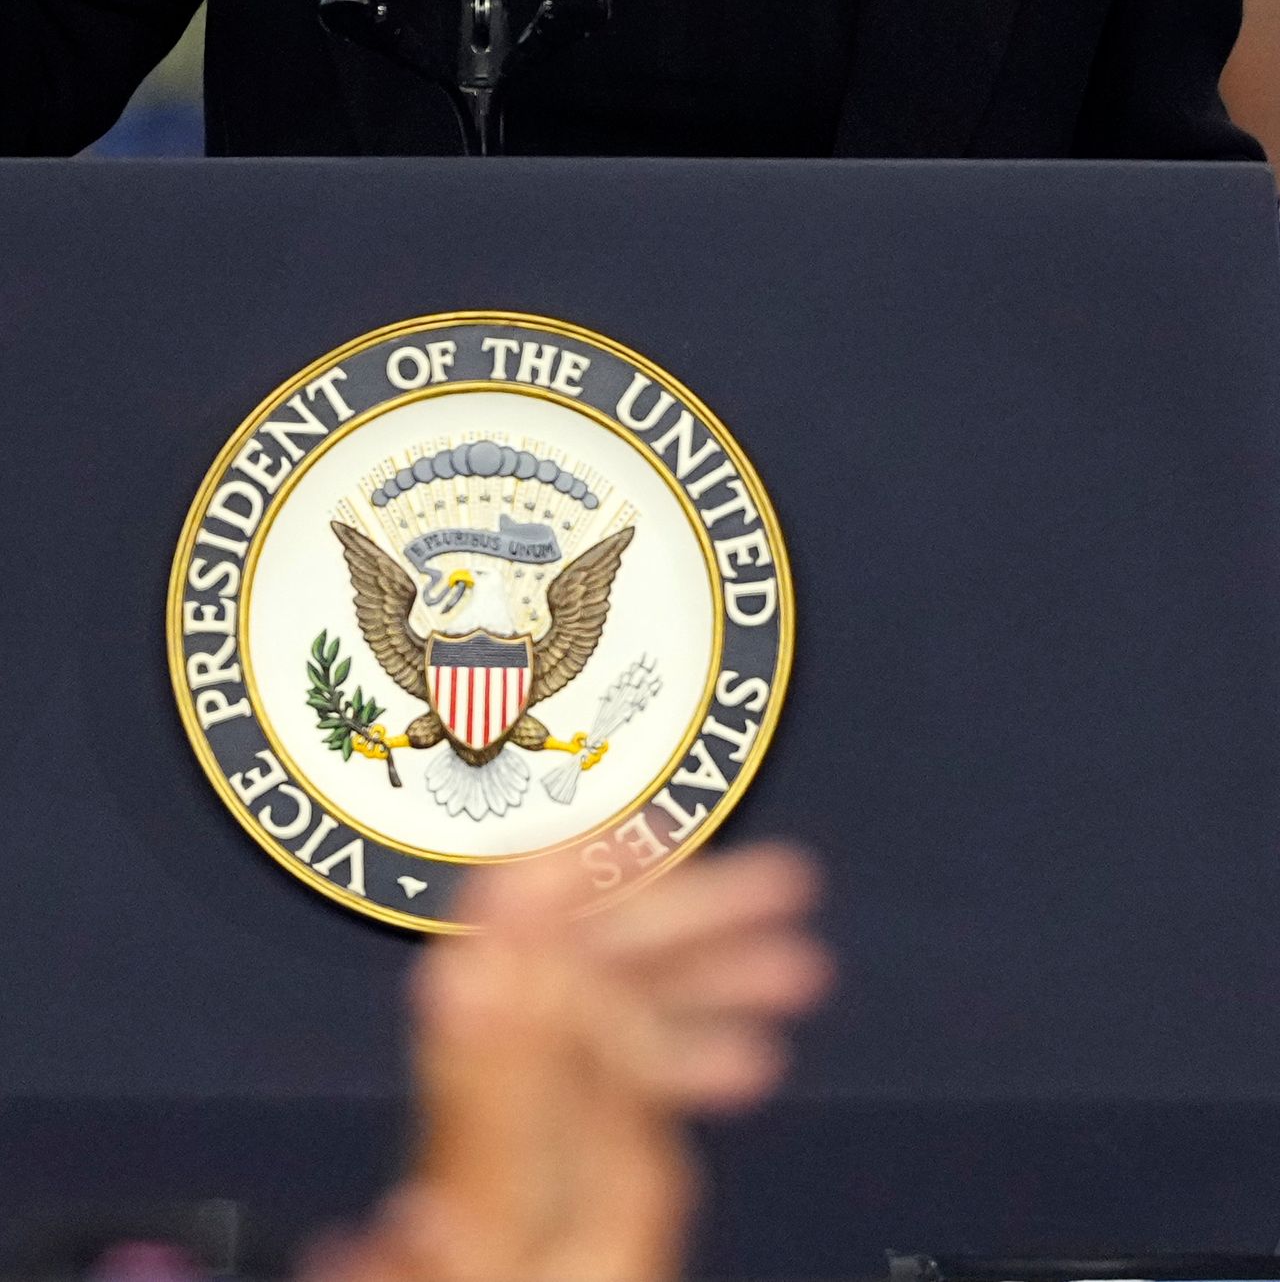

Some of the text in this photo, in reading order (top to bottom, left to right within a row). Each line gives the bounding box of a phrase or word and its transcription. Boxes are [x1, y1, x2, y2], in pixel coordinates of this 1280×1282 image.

[183, 337, 778, 898] VICE PRESIDENT OF THE UNITED STATES
